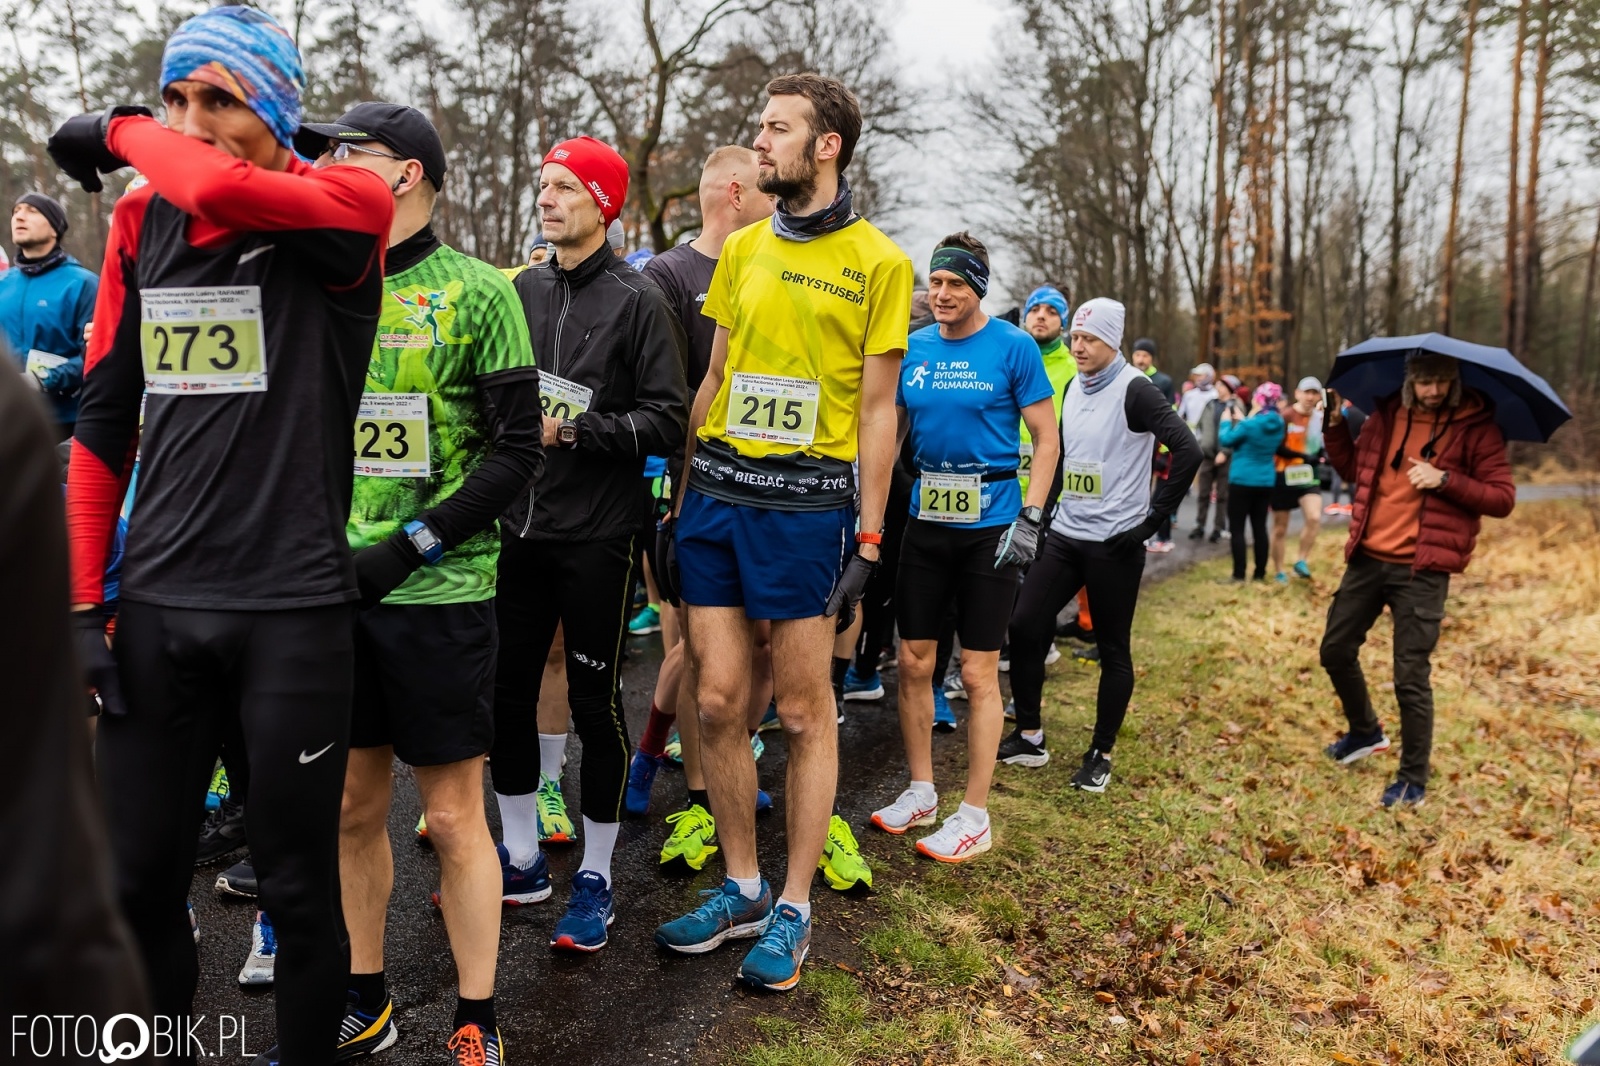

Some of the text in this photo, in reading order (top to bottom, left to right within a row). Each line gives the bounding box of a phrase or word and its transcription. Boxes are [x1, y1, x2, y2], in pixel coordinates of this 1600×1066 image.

[781, 270, 865, 306] CHRYSTUSEM
[153, 324, 239, 371] 273
[933, 371, 977, 380] BYTOMSKI
[936, 361, 970, 370] 12. PKO
[932, 380, 994, 391] PÓŁMARATON
[739, 396, 803, 430] 215
[353, 421, 409, 459] 23
[734, 471, 785, 488] BIEGAĆ
[1067, 473, 1094, 493] 170
[928, 489, 970, 513] 218
